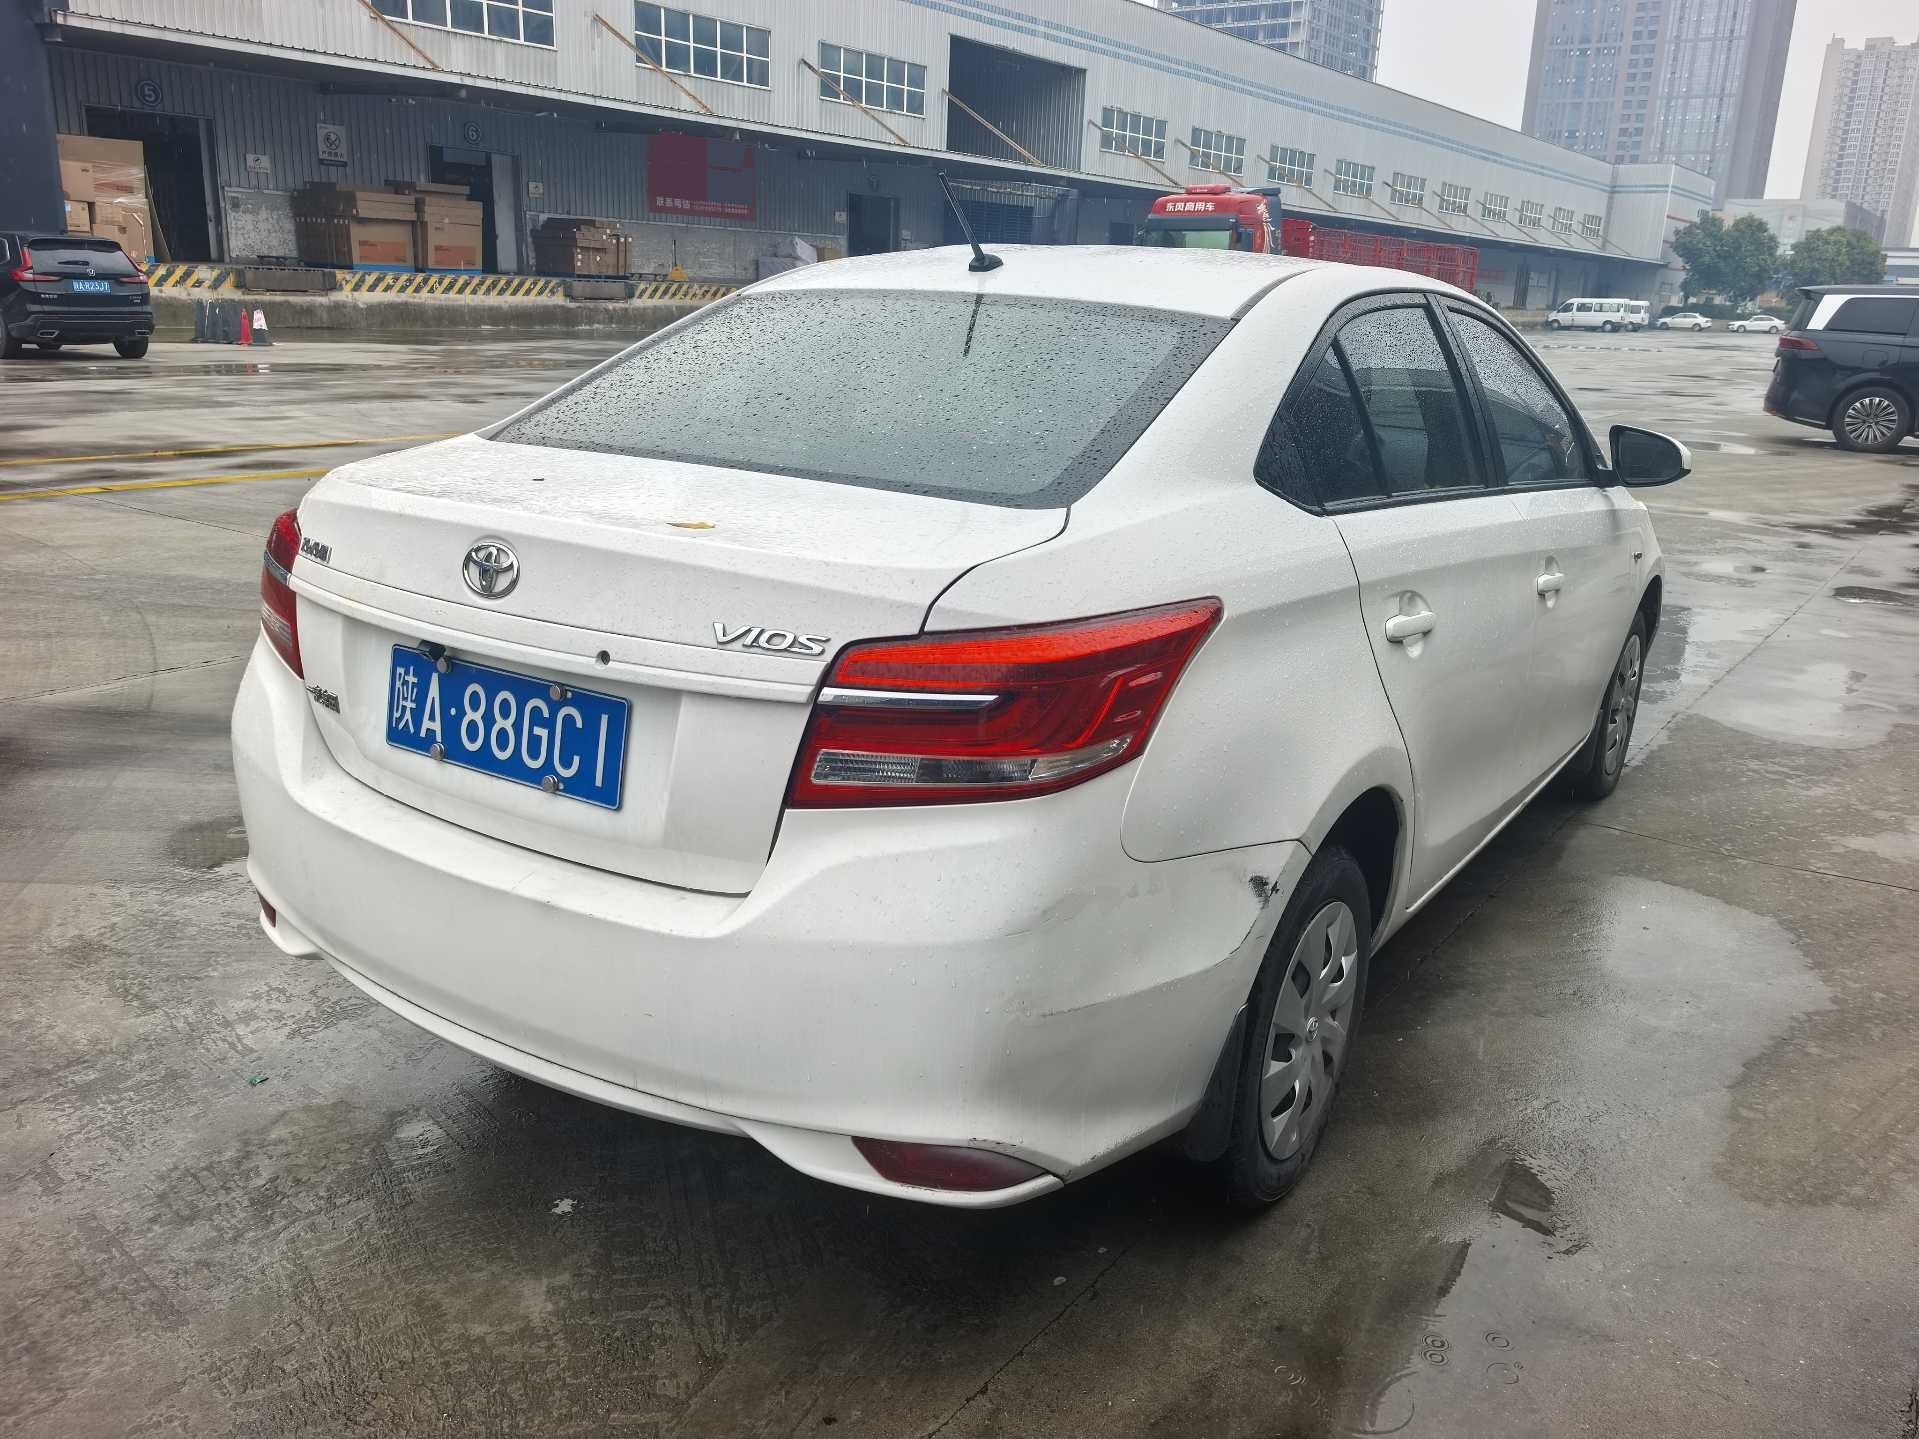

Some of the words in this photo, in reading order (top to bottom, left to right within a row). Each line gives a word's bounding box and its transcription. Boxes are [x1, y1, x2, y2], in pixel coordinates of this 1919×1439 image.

[145, 86, 156, 101] 5
[1165, 201, 1217, 212] 东风商用车
[712, 621, 831, 656] VIOS
